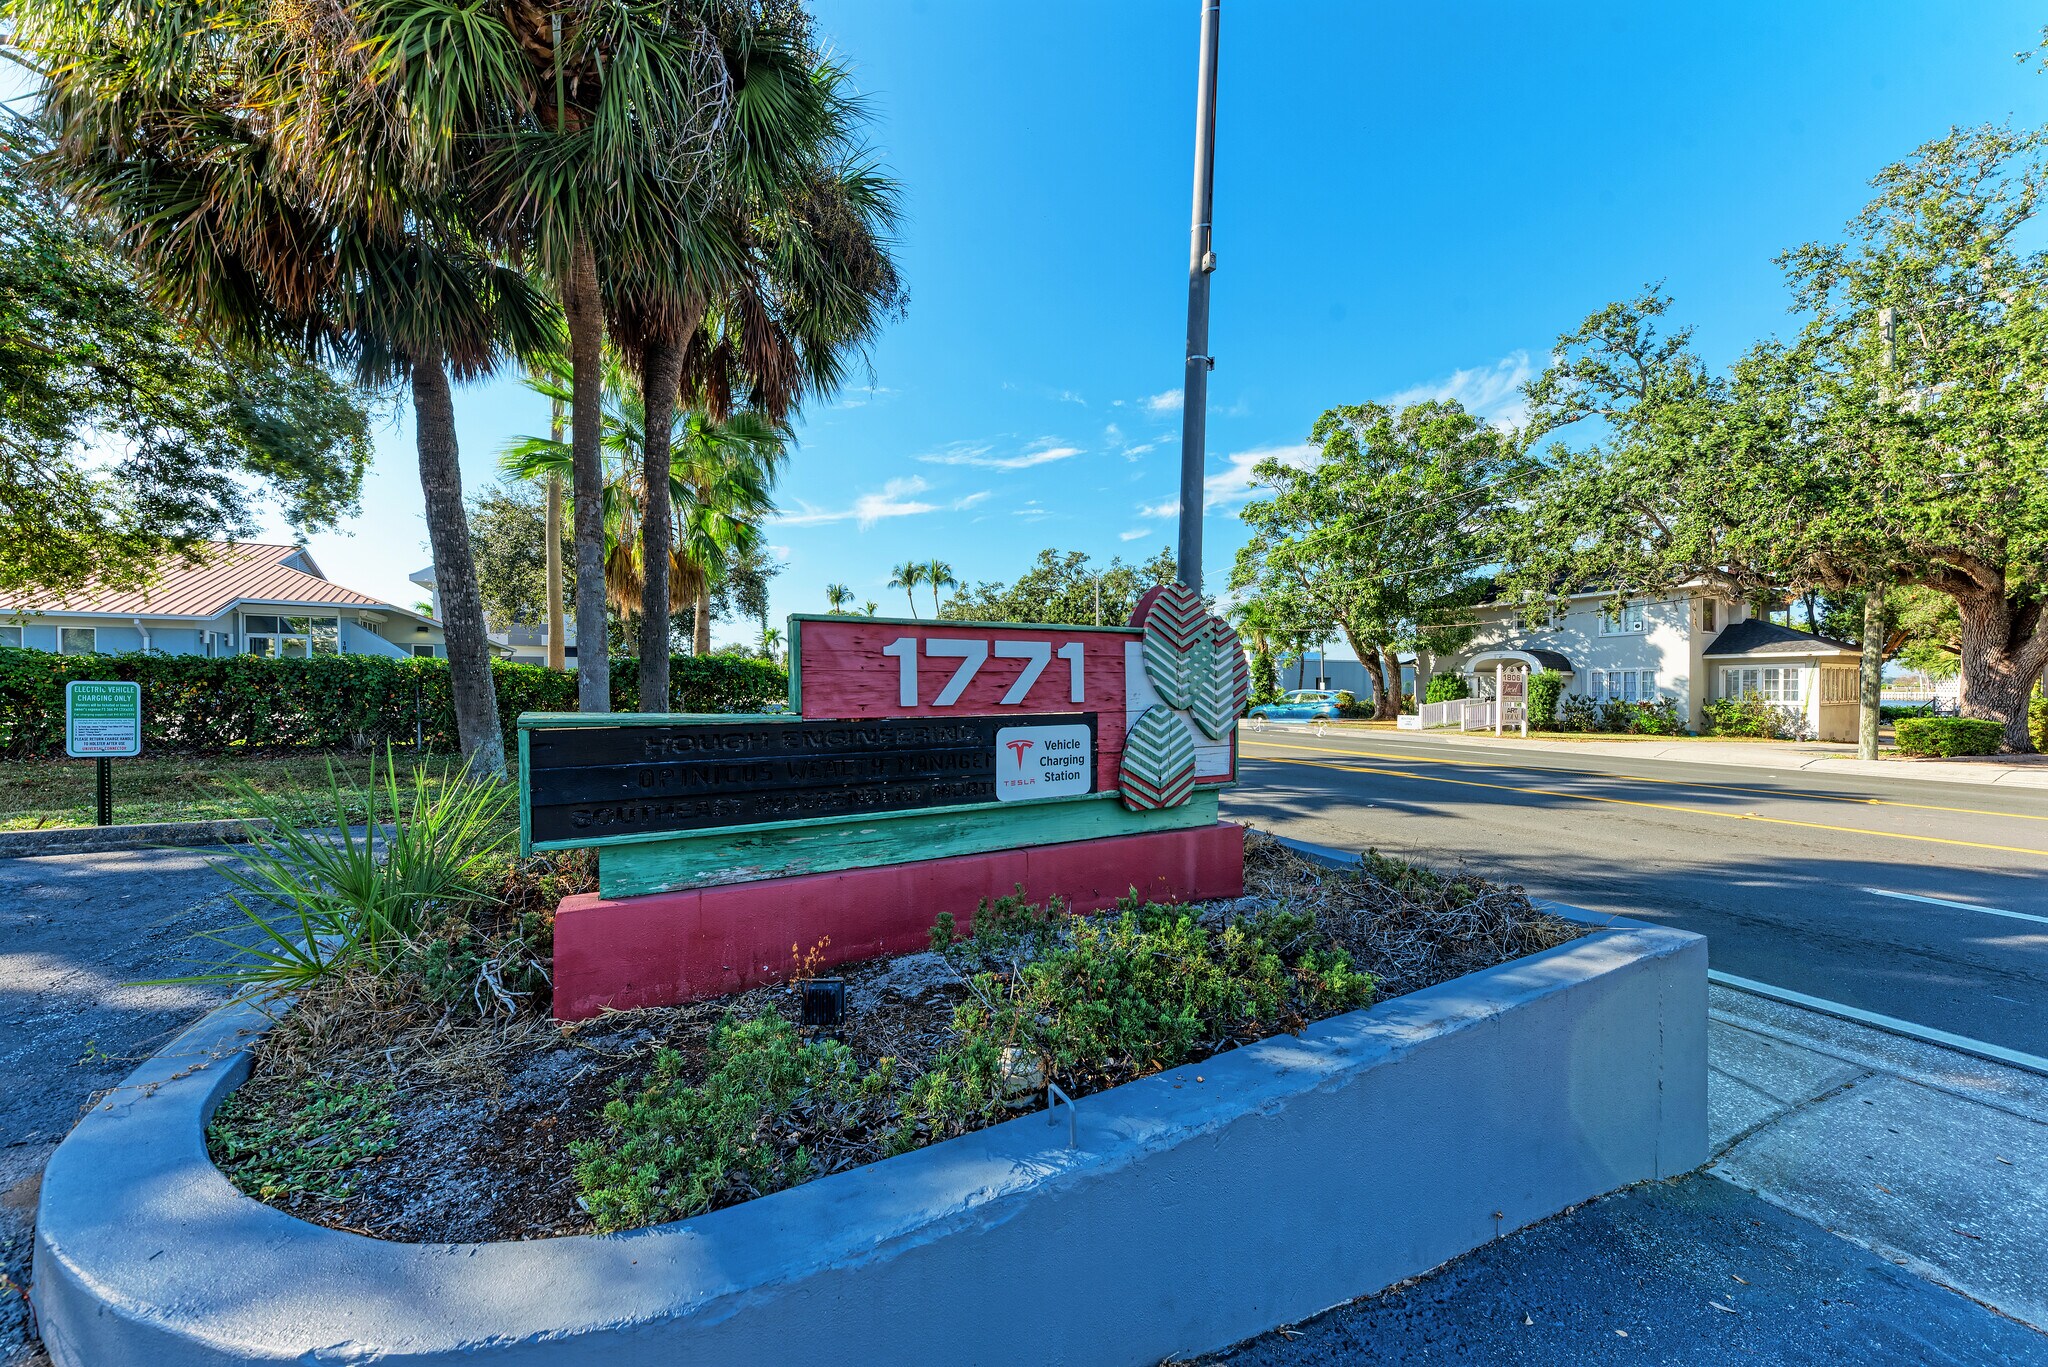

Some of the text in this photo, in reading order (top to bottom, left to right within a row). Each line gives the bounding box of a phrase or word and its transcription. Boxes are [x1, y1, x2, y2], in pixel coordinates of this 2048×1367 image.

[883, 637, 1085, 707] 1771
[645, 732, 769, 755] HOUGH
[782, 726, 983, 749] ENGINEERING,
[1044, 739, 1081, 751] Vehicle
[639, 763, 773, 788] OPINICUS
[787, 756, 884, 780] WEALTH
[1040, 755, 1085, 767] Charging
[1044, 770, 1080, 782] Station
[571, 799, 744, 828] SOUTHEAST
[932, 781, 995, 799] MORT
